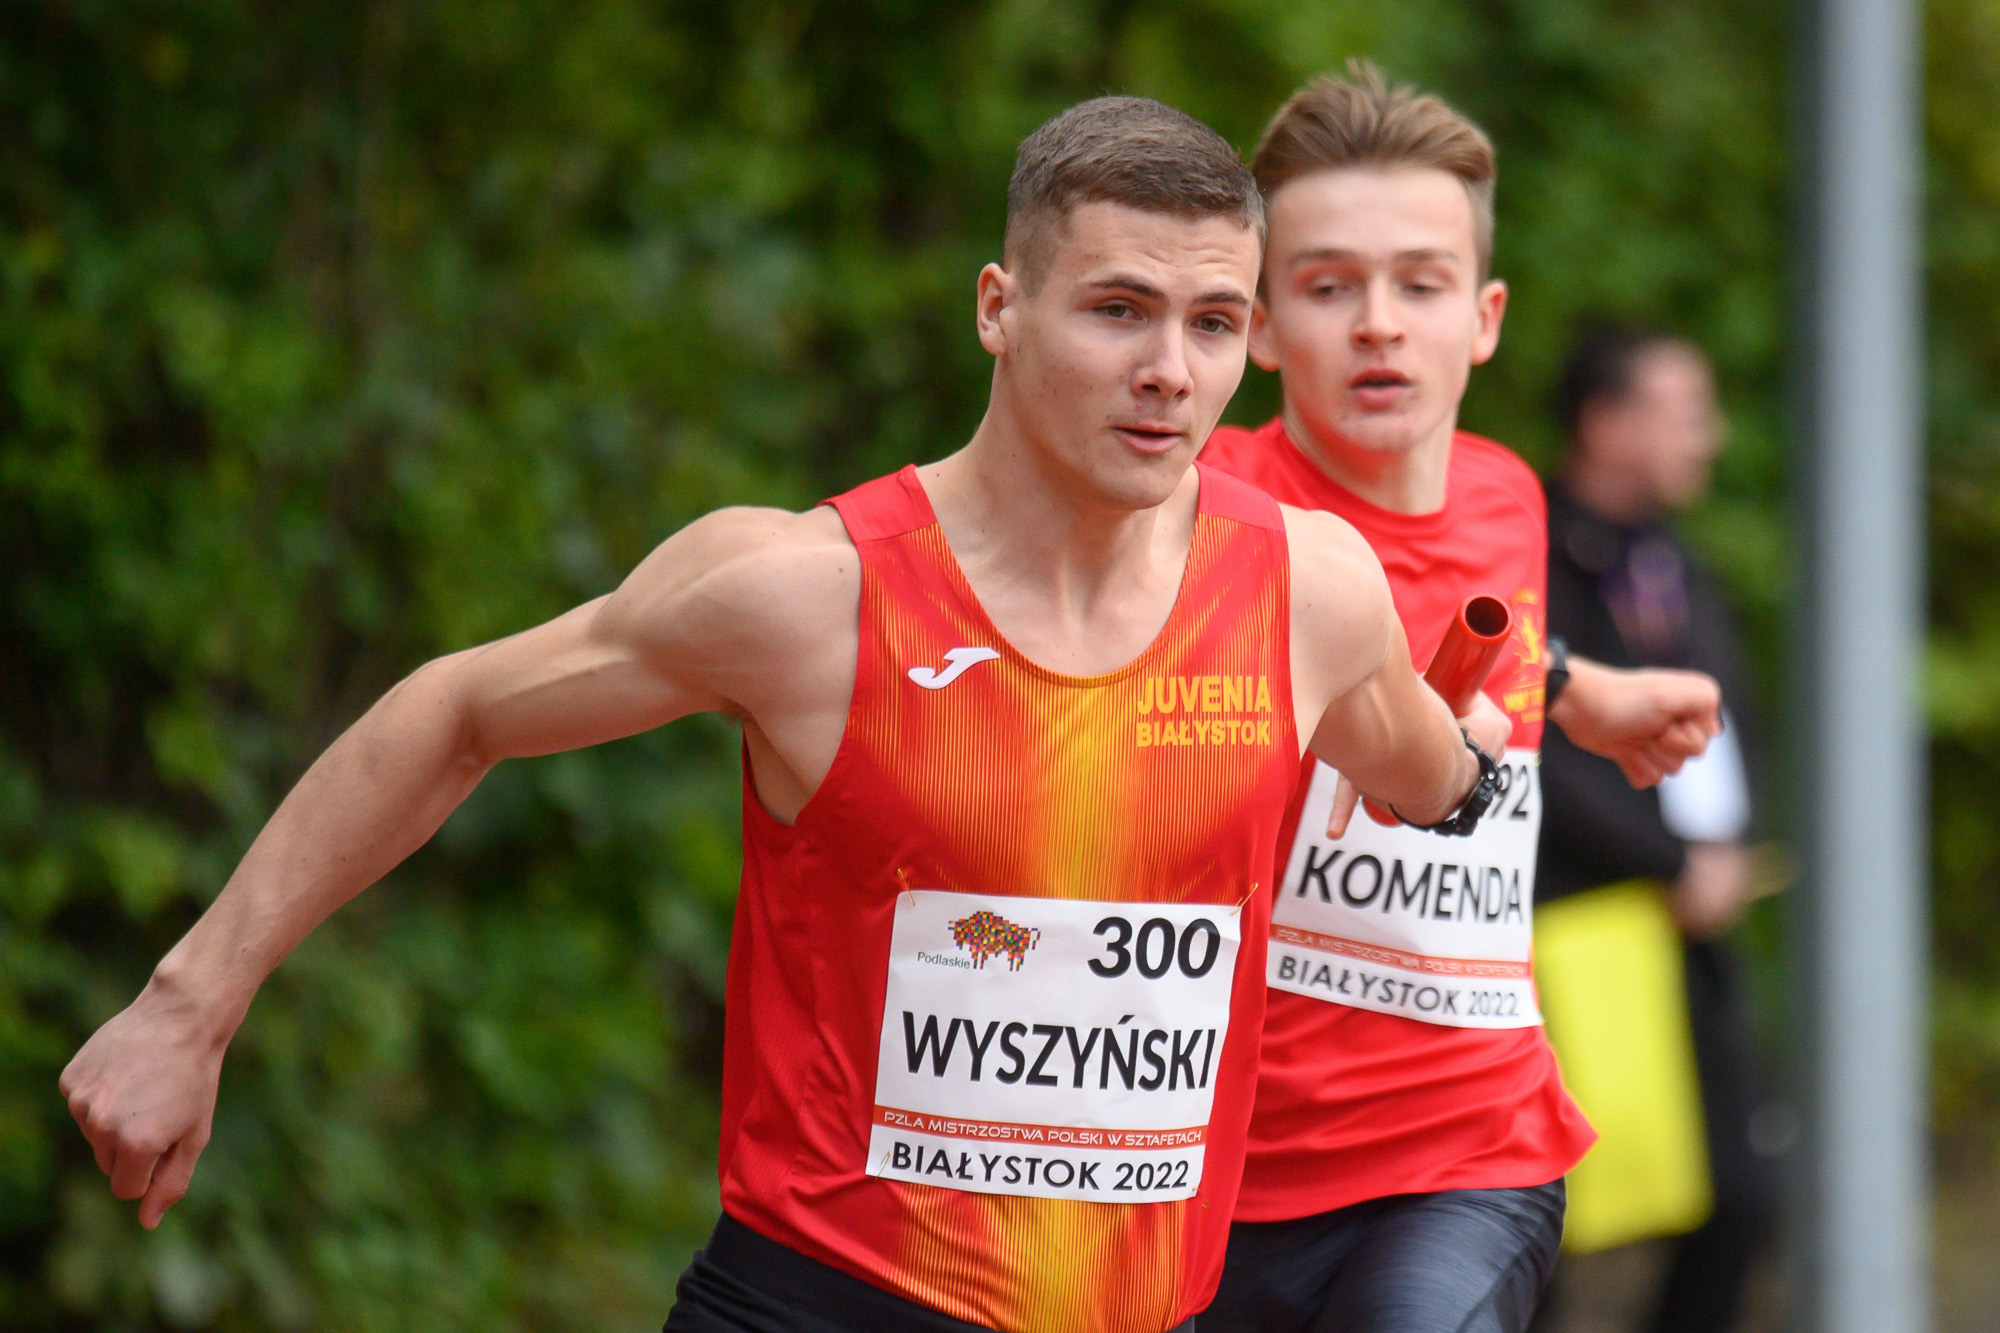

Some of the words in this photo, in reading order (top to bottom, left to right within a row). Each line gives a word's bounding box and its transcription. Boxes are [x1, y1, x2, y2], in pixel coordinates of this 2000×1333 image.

[1137, 675, 1272, 715] JUVENIA
[1136, 720, 1271, 748] BIAŁYSTOK
[1296, 845, 1524, 924] KOMENDA
[916, 951, 971, 970] Podlaskie
[1087, 916, 1222, 980] 300
[1278, 955, 1461, 1016] BIAŁYSTOK
[1466, 990, 1520, 1017] 2022
[902, 1010, 1217, 1092] WYSZYŃSKI
[884, 1111, 925, 1130] PZLA
[927, 1119, 1044, 1142] MISTRZOSTWA
[1047, 1130, 1104, 1145] POLSKI
[1107, 1134, 1122, 1146] W
[1124, 1130, 1202, 1147] SZTAFETACH
[891, 1141, 1102, 1191] BIAŁYSTOK
[1112, 1160, 1190, 1191] 2022
